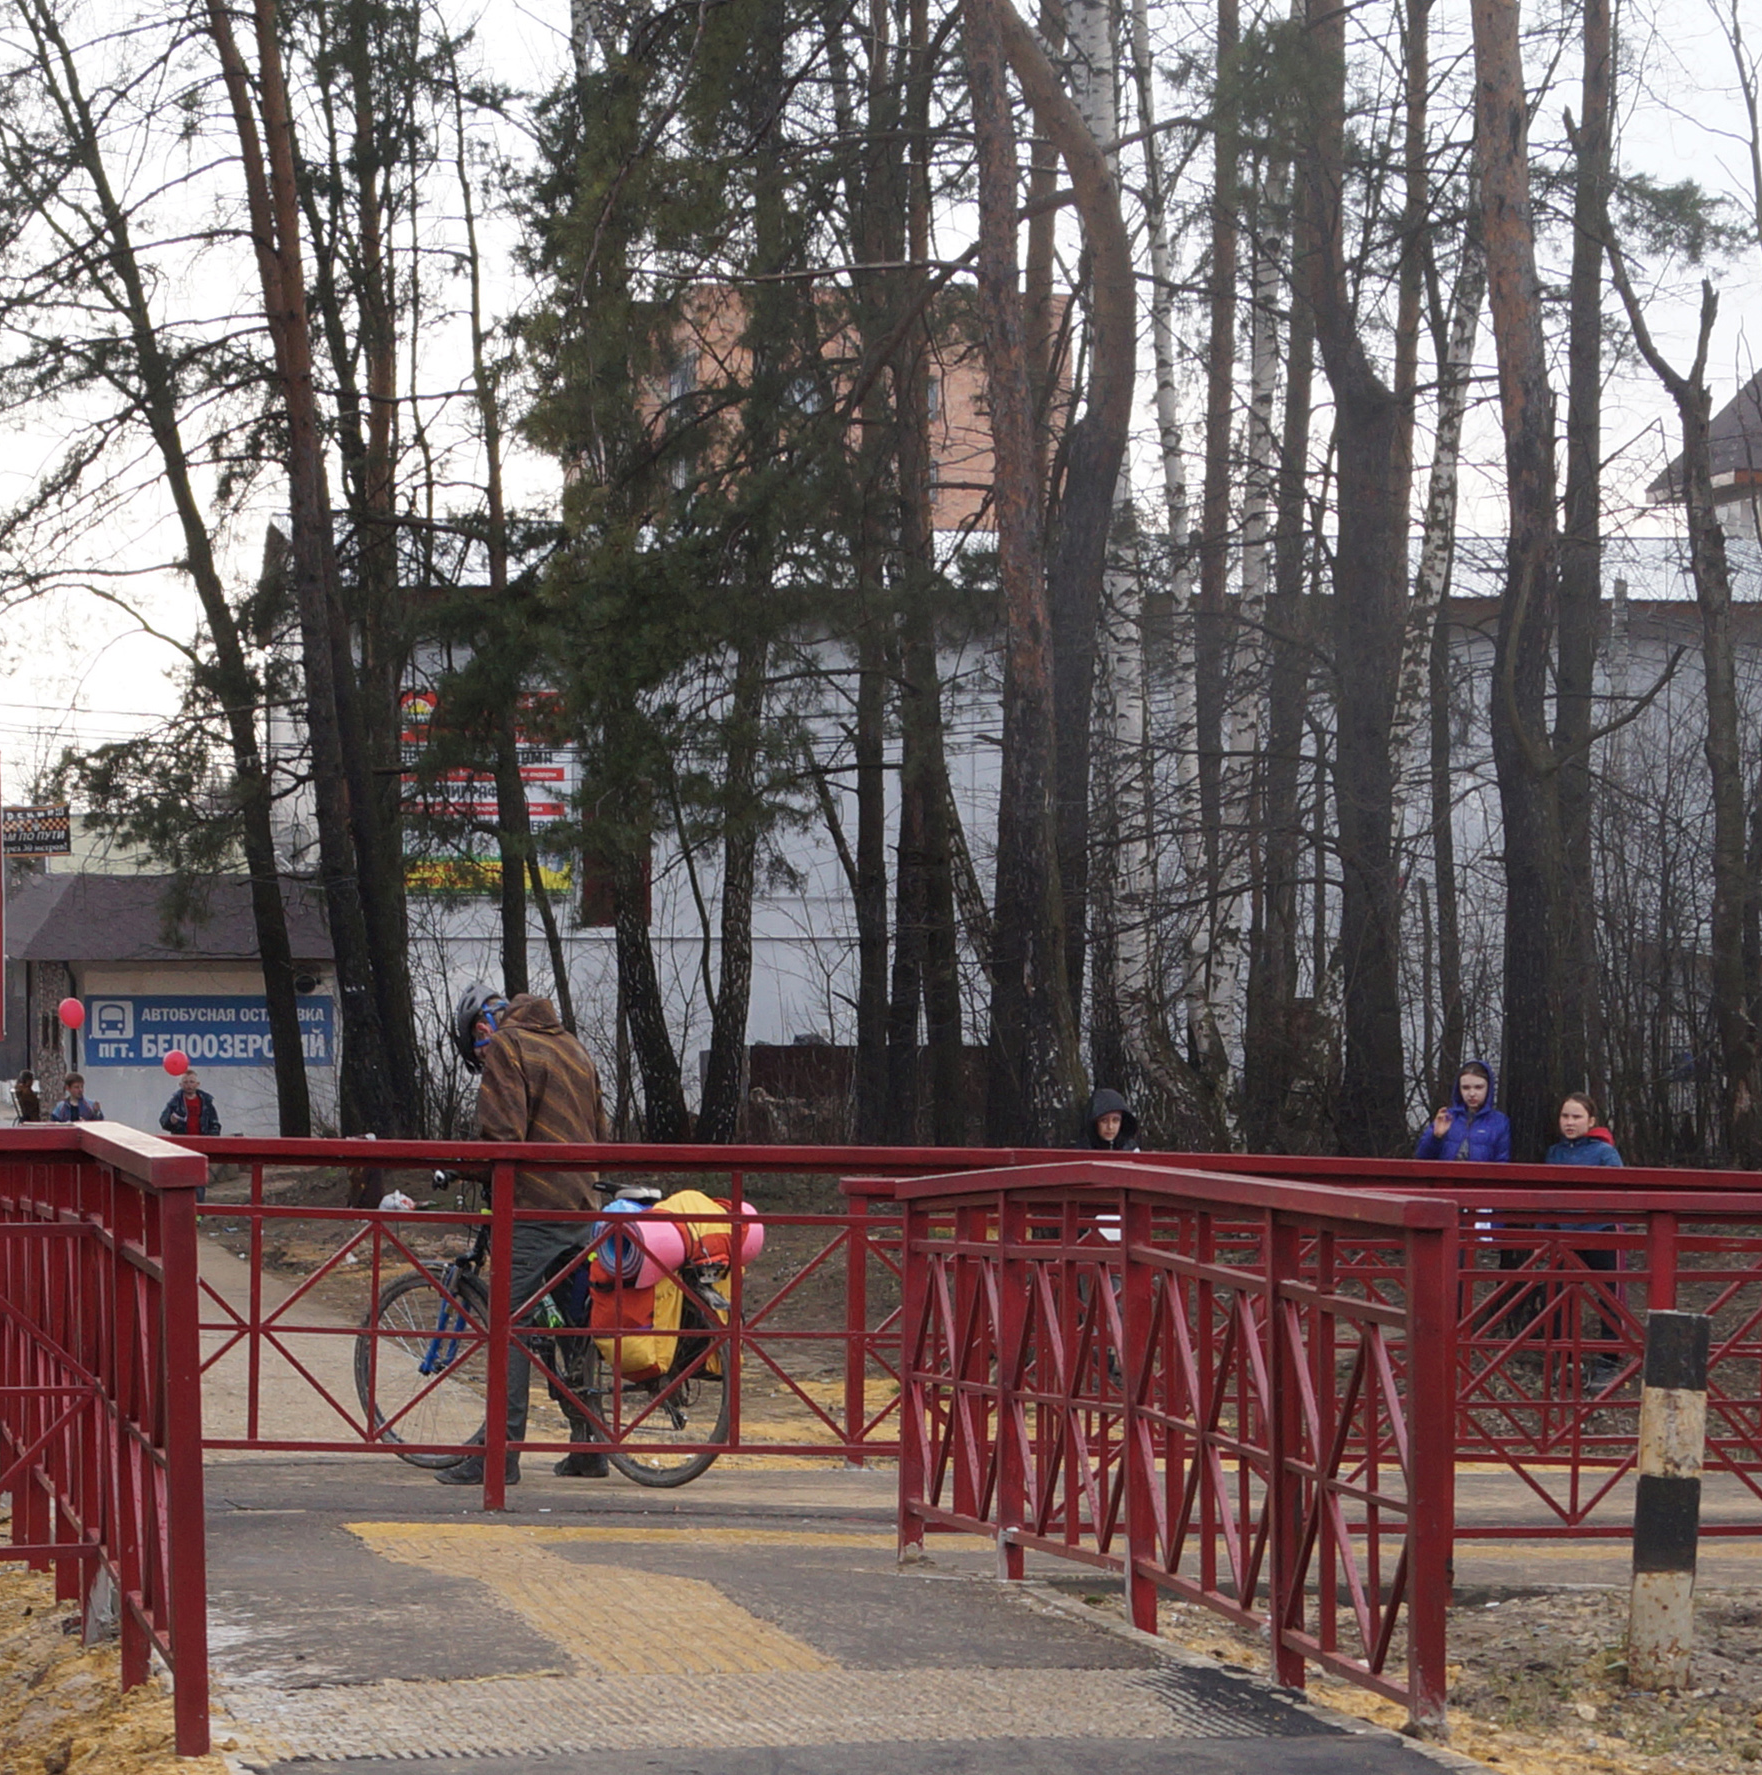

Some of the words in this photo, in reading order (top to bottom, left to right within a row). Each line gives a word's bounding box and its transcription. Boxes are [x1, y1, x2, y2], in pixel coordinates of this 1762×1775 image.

[19, 832, 35, 841] ПО
[36, 831, 65, 840] ПУТИ
[141, 1008, 236, 1022] АВТОБУСНАЯ
[240, 1008, 325, 1022] ОСТВКА
[141, 1028, 325, 1059] БЕЛООЗЕРСЙ
